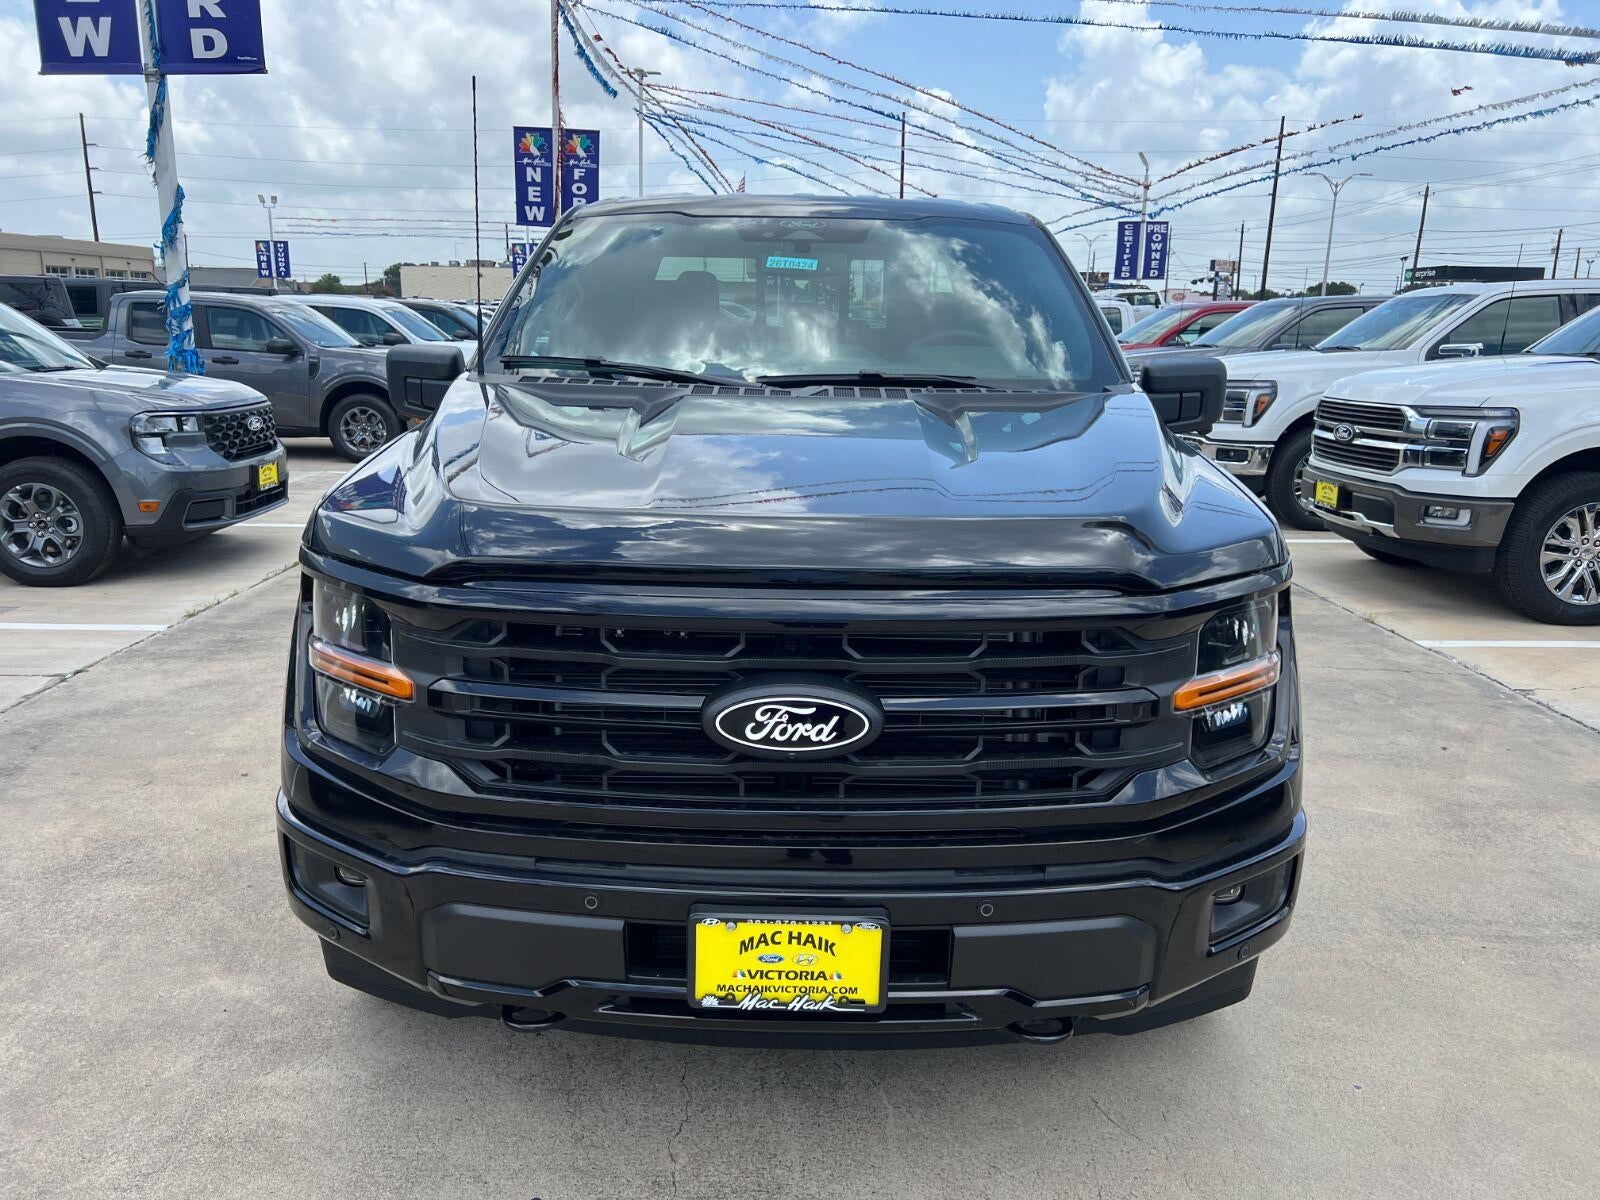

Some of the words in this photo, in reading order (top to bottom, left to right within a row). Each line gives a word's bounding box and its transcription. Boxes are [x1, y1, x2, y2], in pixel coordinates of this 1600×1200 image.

[58, 0, 112, 57] W
[524, 167, 545, 222] NEW
[571, 168, 587, 207] FOR
[1147, 224, 1167, 233] PRE
[260, 254, 270, 276] NEW
[277, 243, 286, 276] HYUNDAI
[1121, 223, 1134, 278] CERTIFIED
[1149, 233, 1163, 277] OWNED
[1406, 268, 1436, 279] eerprise
[744, 704, 840, 742] Ford
[739, 931, 783, 955] MAC
[787, 931, 837, 957] HAIK
[716, 984, 858, 995] MACHAIKVICTORIA.COM
[747, 969, 828, 981] VICTORIA
[738, 992, 786, 1011] Mac
[787, 993, 842, 1012] Haik
